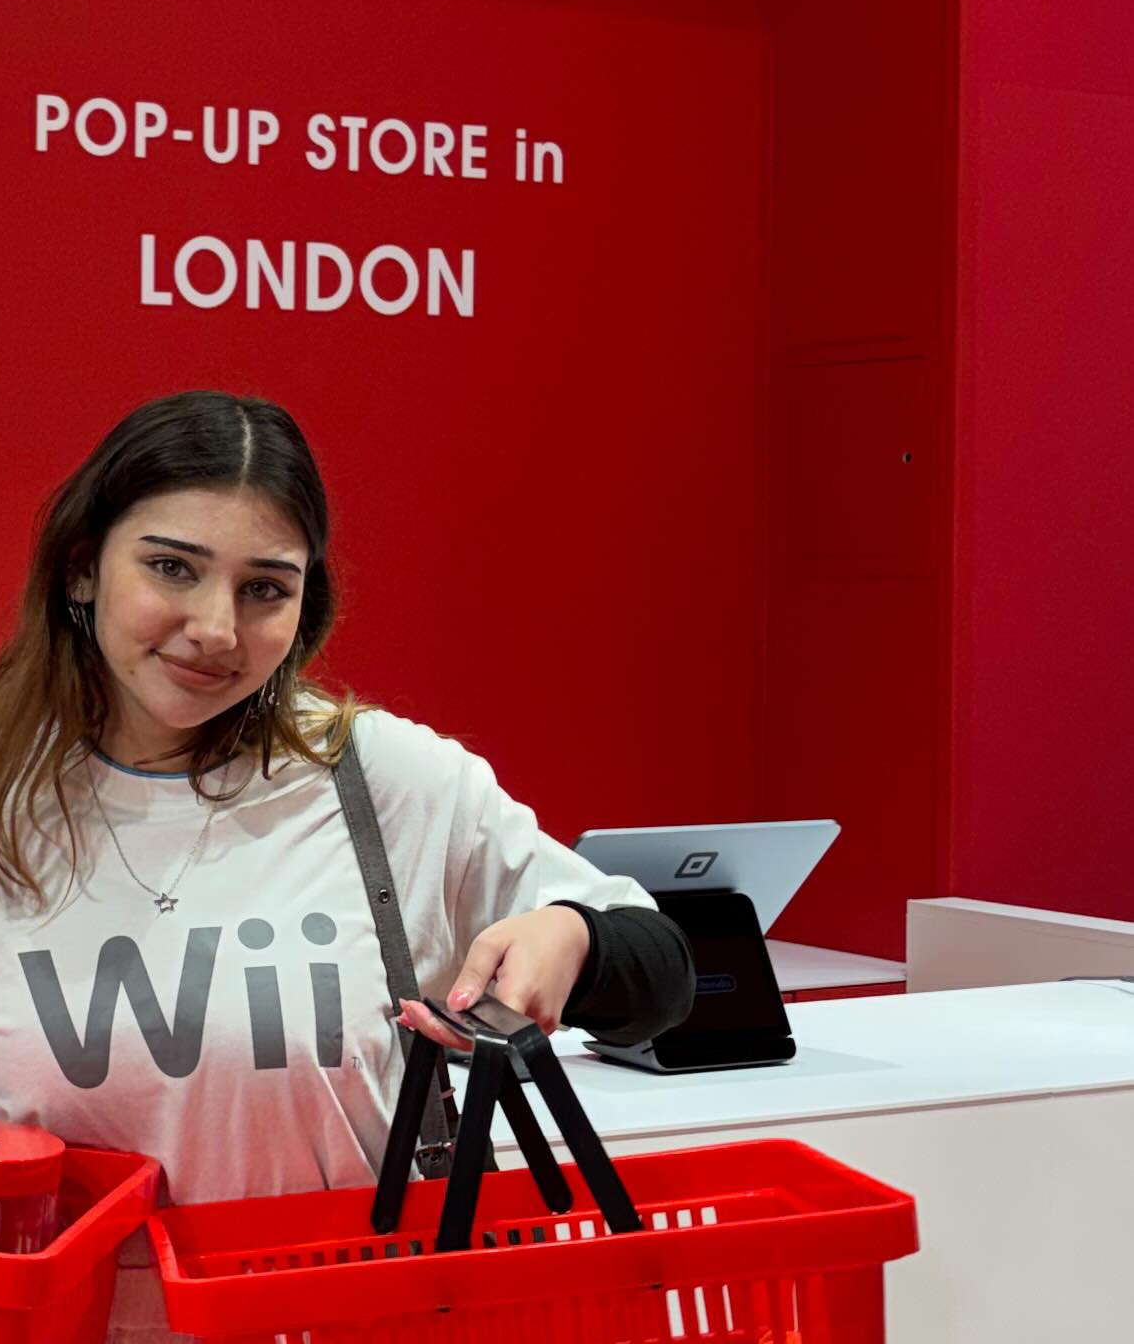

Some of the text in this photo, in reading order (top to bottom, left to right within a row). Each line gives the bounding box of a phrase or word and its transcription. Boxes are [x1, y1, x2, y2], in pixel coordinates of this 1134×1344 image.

[35, 93, 563, 184] POP-UP STORE in
[140, 233, 475, 317] LONDON
[18, 912, 344, 1089] Wii
